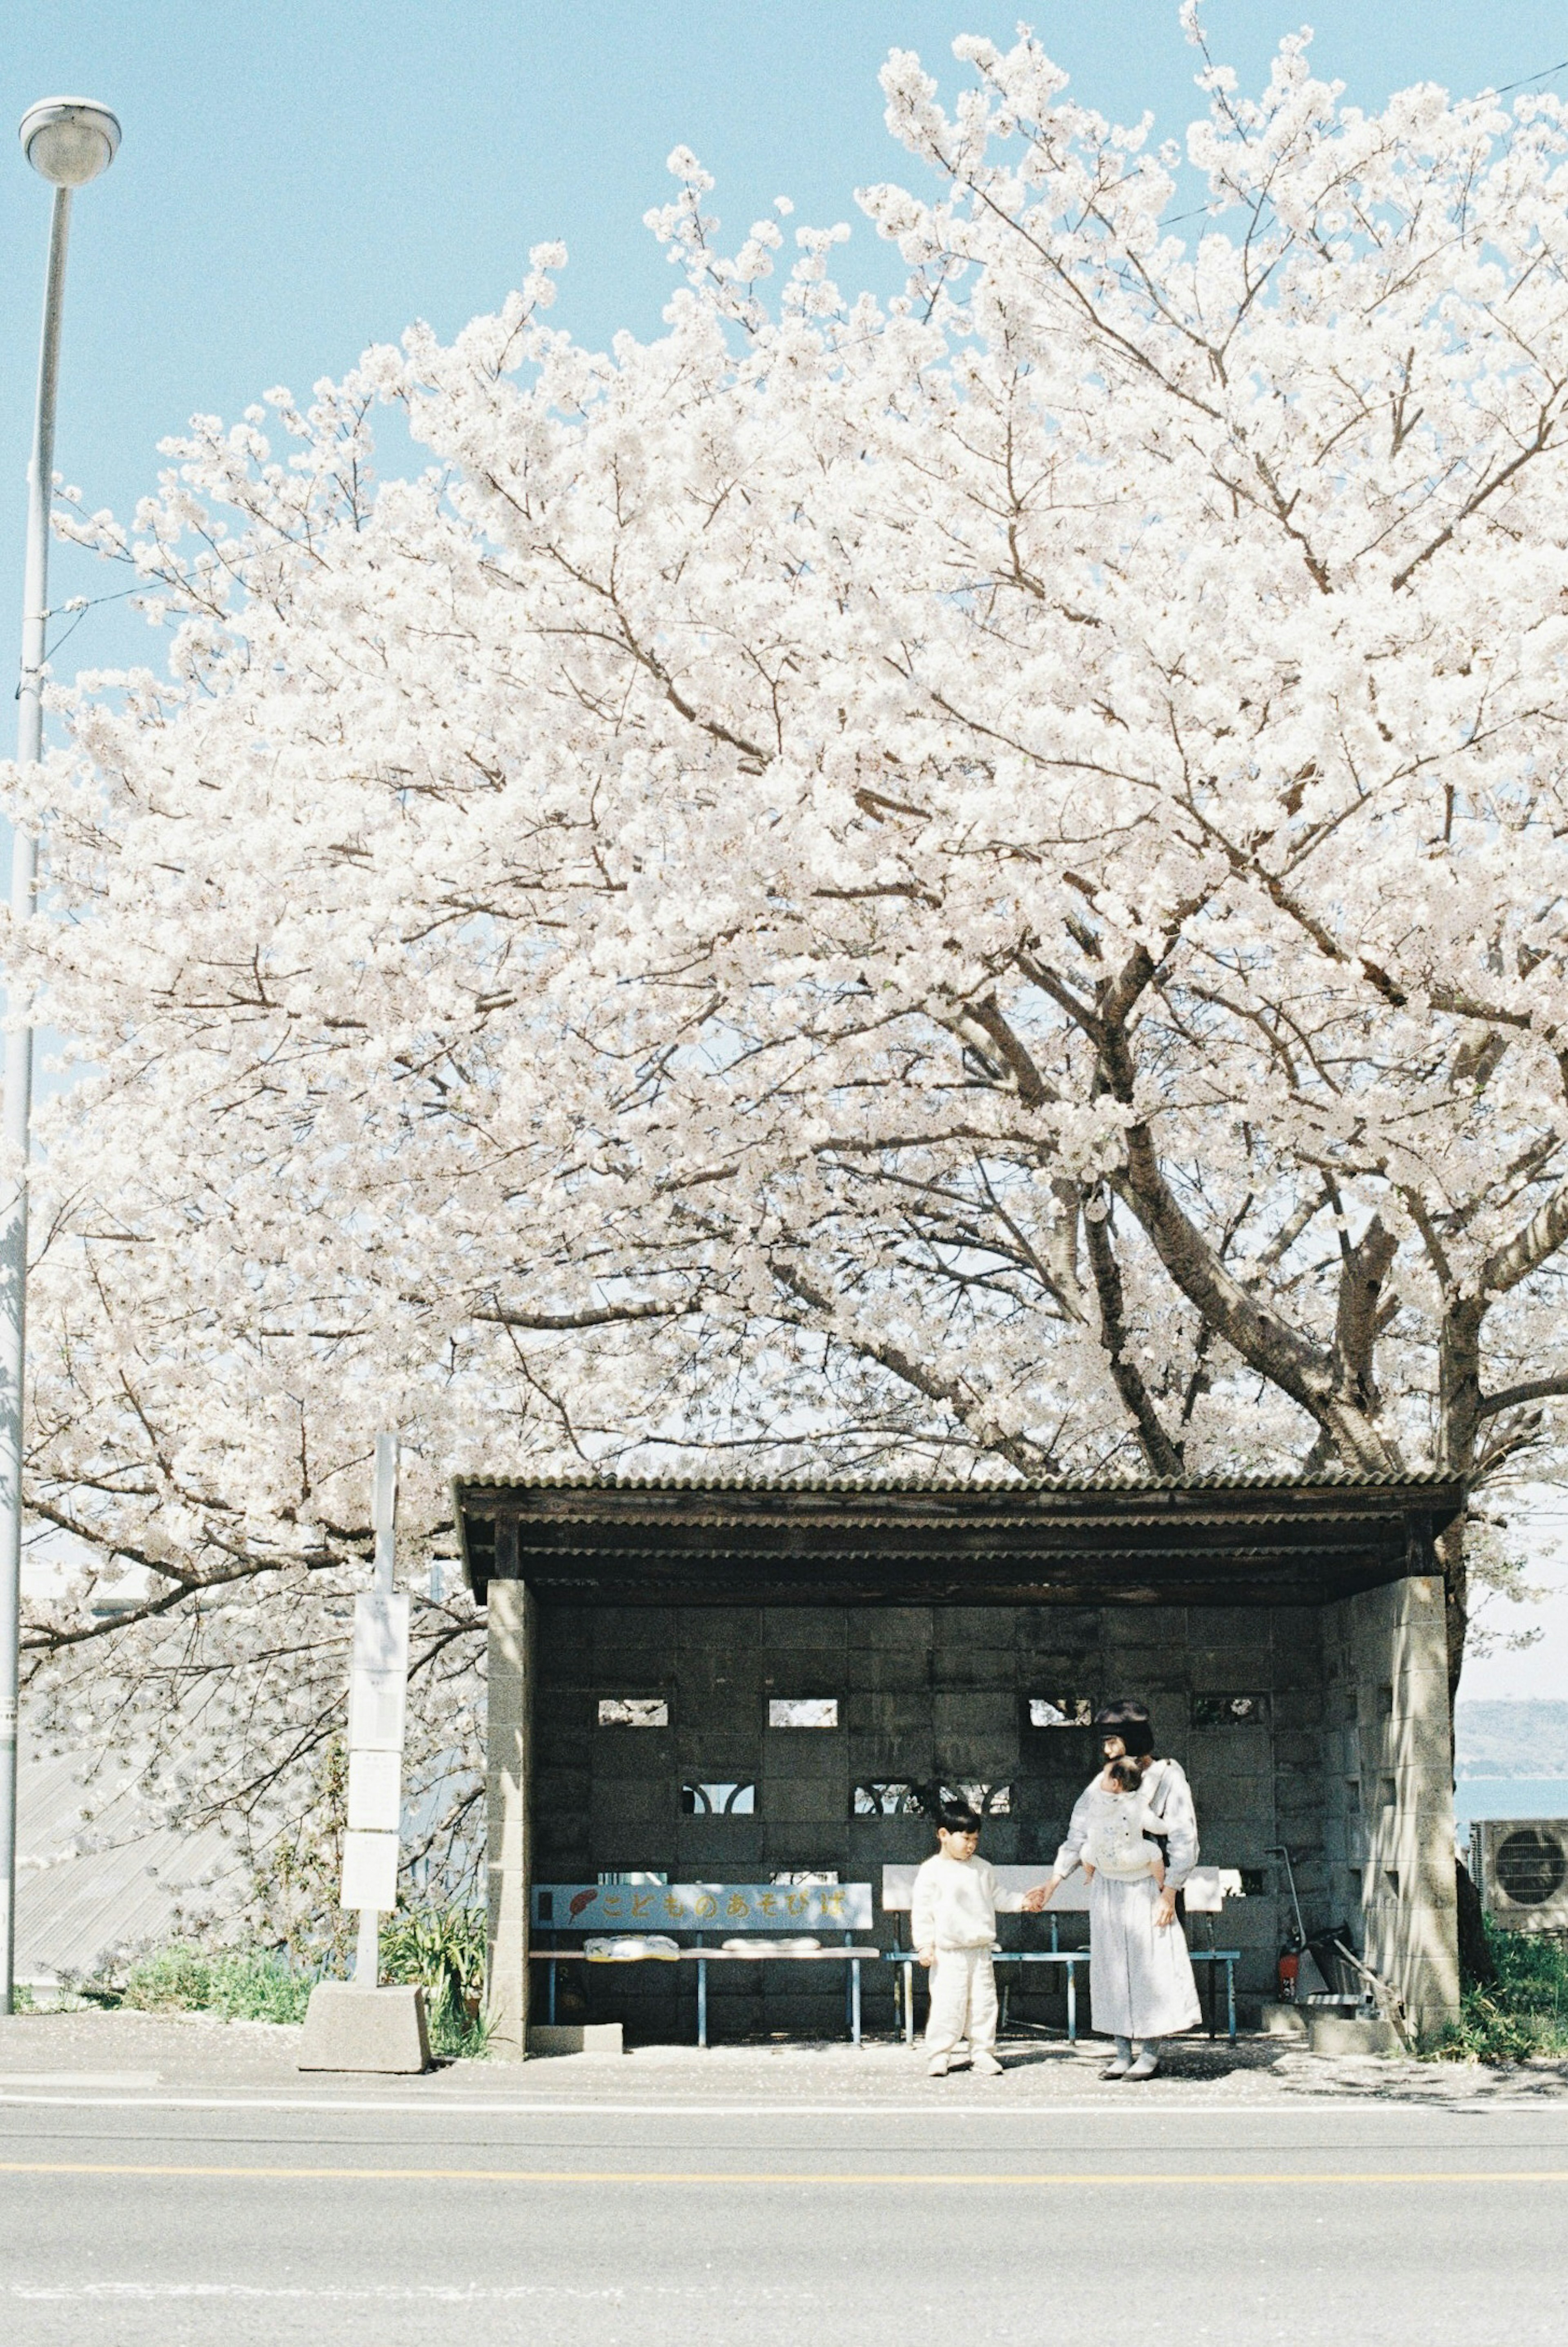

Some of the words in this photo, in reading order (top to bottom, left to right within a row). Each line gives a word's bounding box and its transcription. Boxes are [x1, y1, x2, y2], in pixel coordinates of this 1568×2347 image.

[603, 1891, 846, 1917] こどものあそびば
